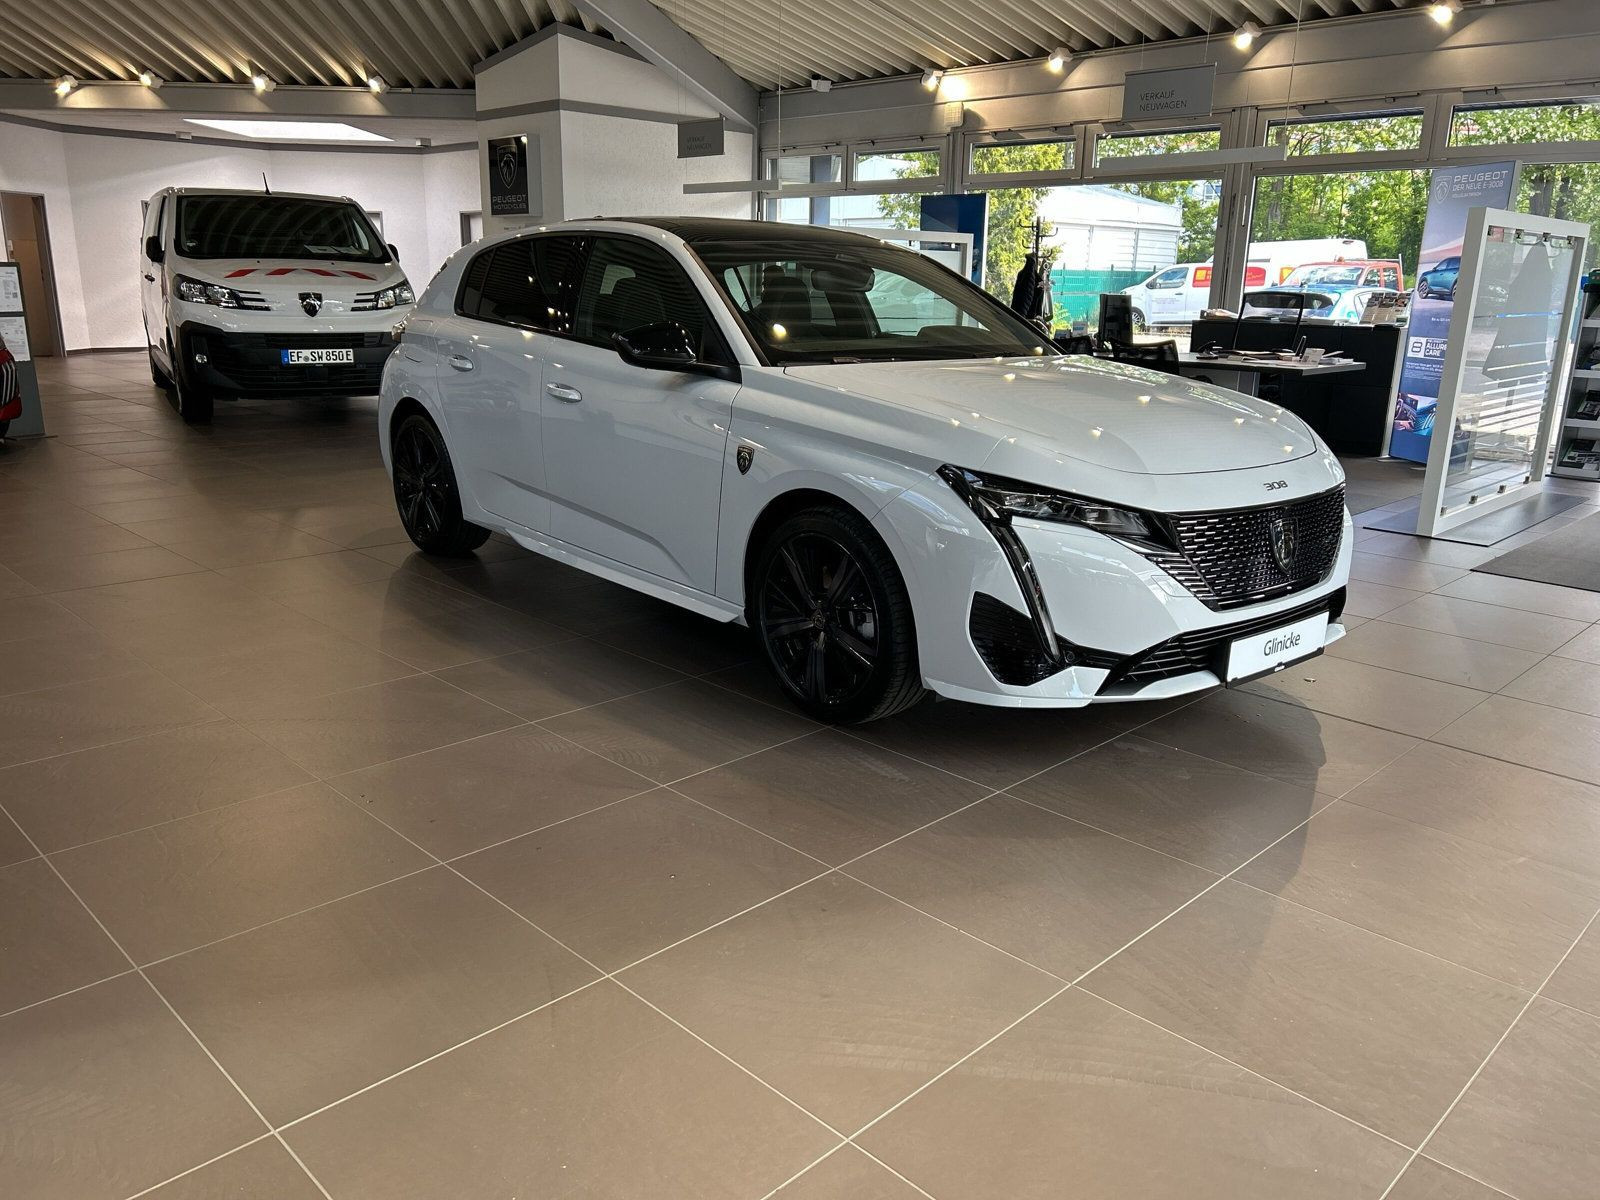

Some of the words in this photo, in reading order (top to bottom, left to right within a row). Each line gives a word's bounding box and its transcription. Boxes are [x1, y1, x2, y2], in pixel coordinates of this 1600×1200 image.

[1140, 90, 1175, 101] VERKAUF
[1140, 100, 1187, 112] NEUWAGEN
[1453, 171, 1508, 183] PEUGEOT
[1466, 182, 1481, 190] NEUE
[492, 194, 527, 203] PEUGEOT
[289, 351, 303, 362] EF
[310, 351, 324, 362] SW
[1263, 480, 1288, 491] 308
[1263, 632, 1301, 657] Glinicke
